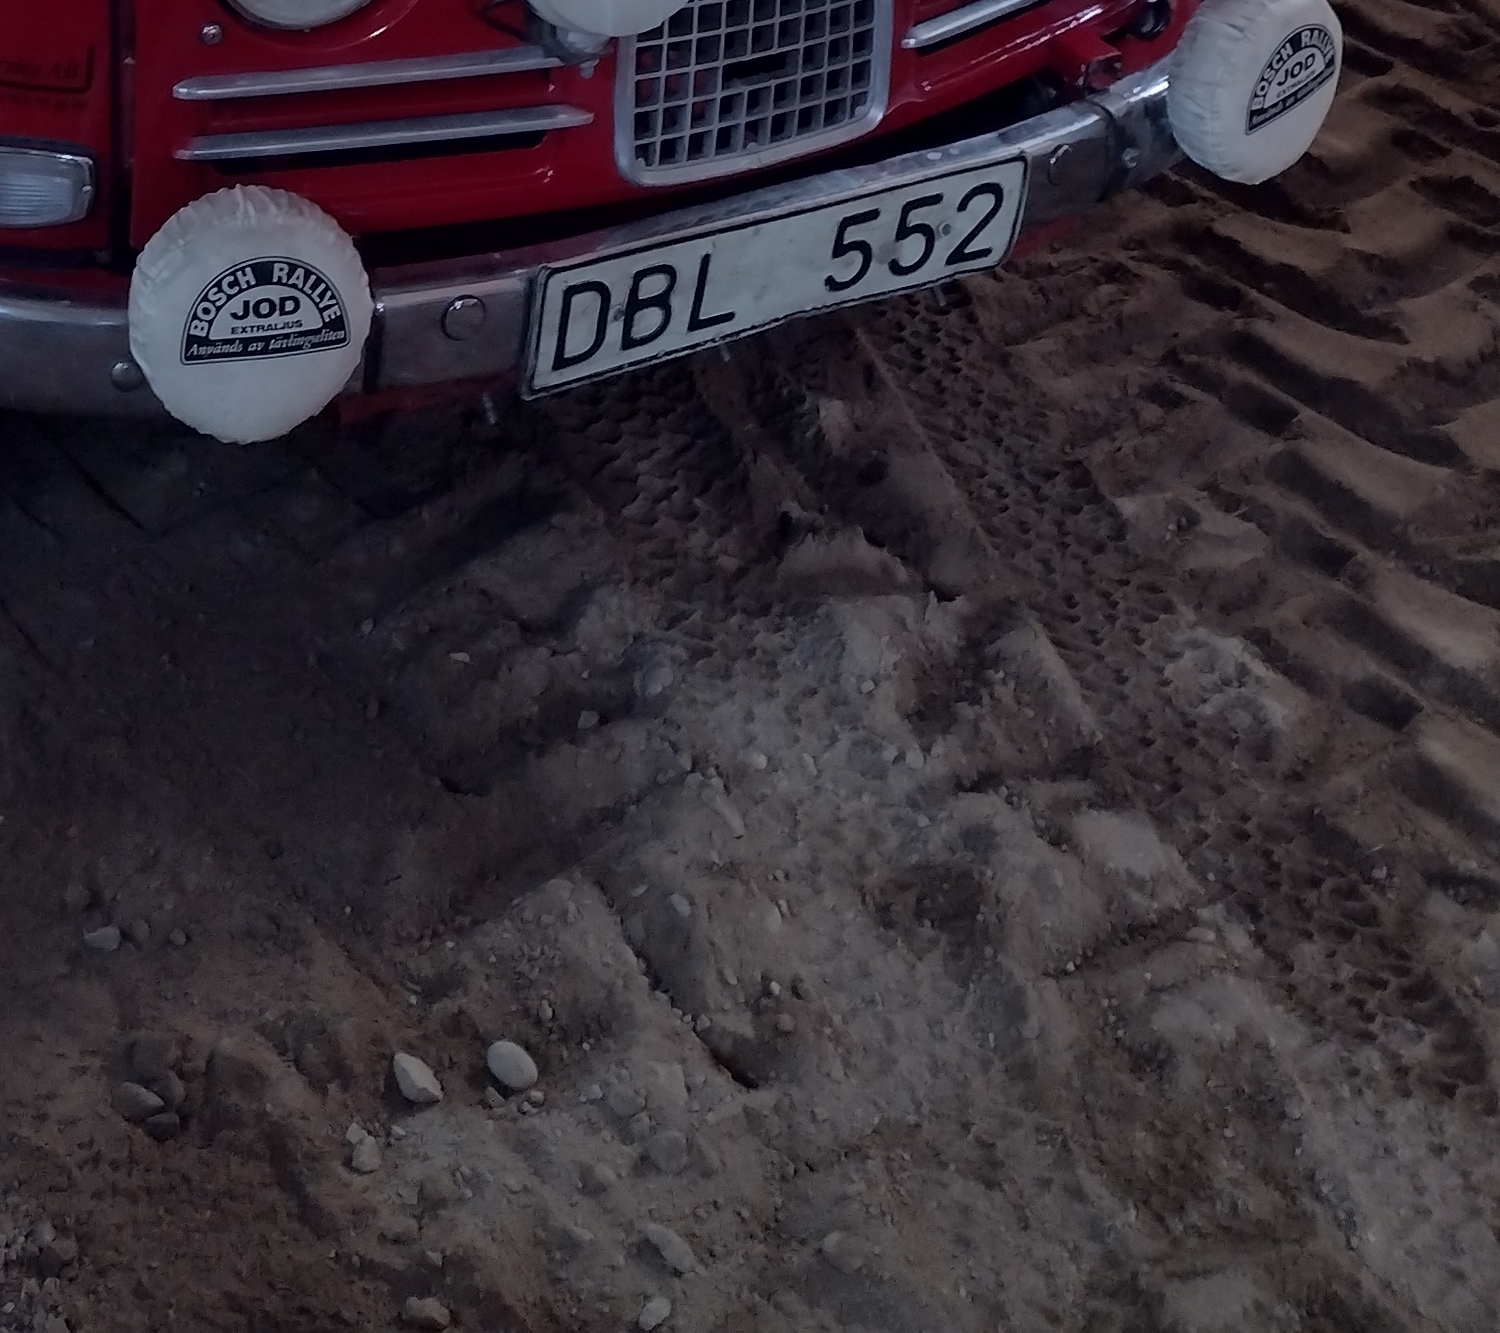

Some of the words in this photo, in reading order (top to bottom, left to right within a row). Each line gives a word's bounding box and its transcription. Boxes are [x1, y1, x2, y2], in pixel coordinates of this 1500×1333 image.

[1251, 41, 1294, 111] BOSCH
[1276, 52, 1316, 87] JOD
[551, 252, 736, 372] DBL
[823, 181, 1005, 293] 552
[189, 266, 257, 338] BOSCH
[272, 262, 341, 323] RALLYE
[230, 295, 301, 321] JOD
[230, 319, 304, 335] EXTRALJUS
[187, 341, 243, 357] Används
[247, 340, 266, 352] av
